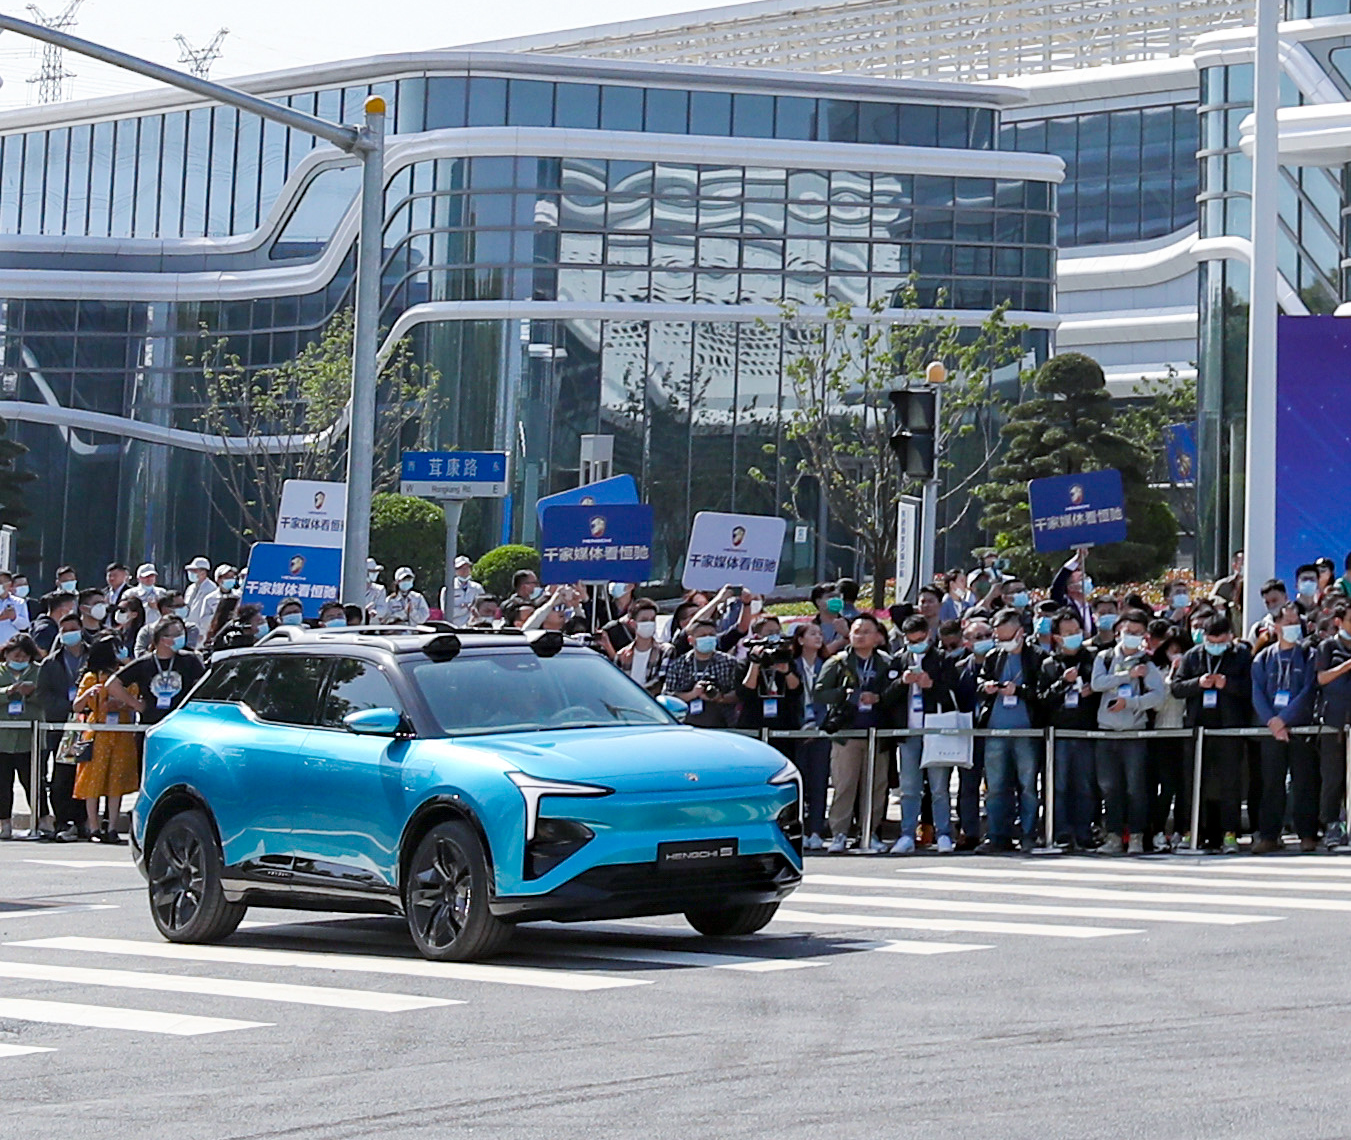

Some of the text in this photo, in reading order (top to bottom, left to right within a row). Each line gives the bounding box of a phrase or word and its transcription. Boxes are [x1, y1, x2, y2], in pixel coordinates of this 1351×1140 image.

[428, 457, 478, 477] 茸康路
[406, 483, 415, 493] W
[492, 484, 499, 494] E
[281, 516, 344, 532] 千家媒体看恒
[543, 545, 649, 562] 千家媒体看恒驰
[690, 554, 777, 572] 千家媒体看恒驰
[246, 581, 338, 598] 千家媒体看恒驰
